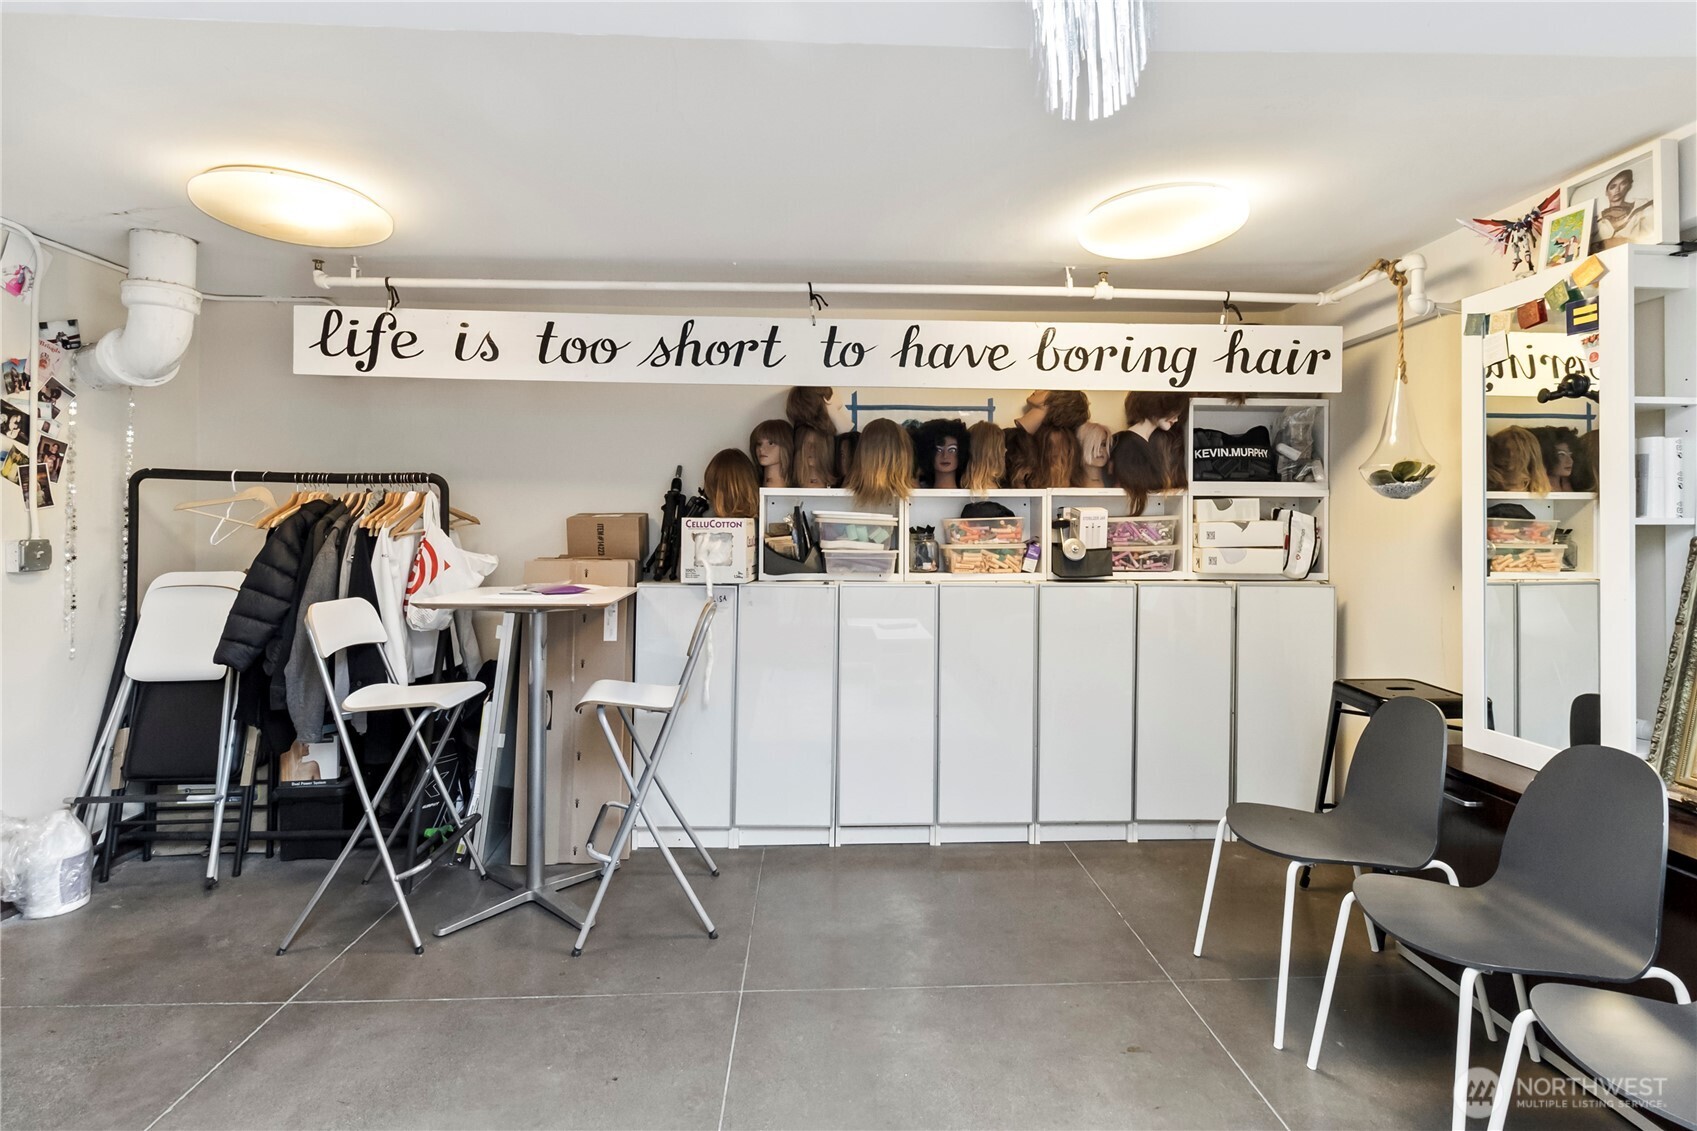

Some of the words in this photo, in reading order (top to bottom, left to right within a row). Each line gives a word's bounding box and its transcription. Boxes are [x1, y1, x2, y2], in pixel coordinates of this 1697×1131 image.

[309, 309, 425, 373] life
[455, 322, 500, 362] is
[536, 321, 632, 365] too
[637, 319, 787, 368] short
[820, 326, 877, 368] to
[890, 325, 1016, 372] have
[1029, 327, 1198, 388] boring
[1213, 329, 1332, 376] hair
[1194, 447, 1268, 459] KEVIN.MURPHY
